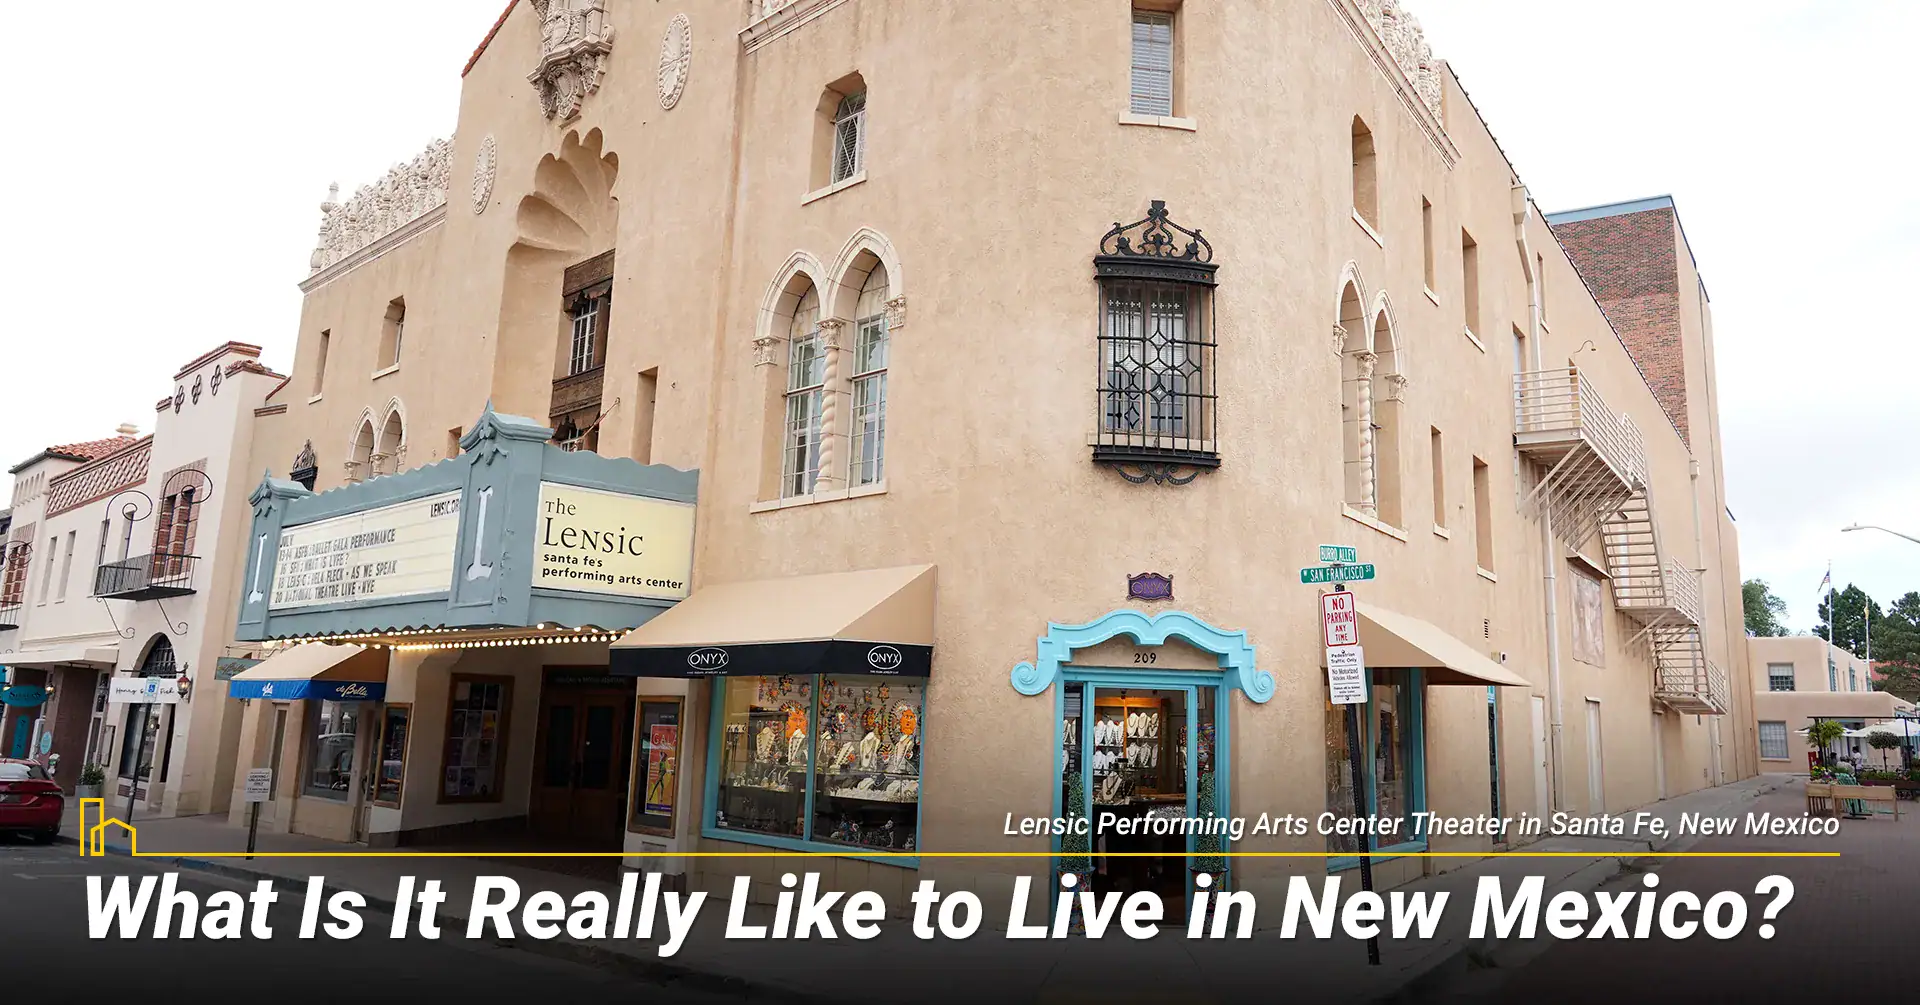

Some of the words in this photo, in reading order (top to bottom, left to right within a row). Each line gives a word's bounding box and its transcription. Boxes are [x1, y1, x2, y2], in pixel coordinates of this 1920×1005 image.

[545, 498, 576, 516] The
[280, 534, 294, 548] JULY
[333, 537, 348, 551] GALA
[350, 528, 396, 549] PERFORMANCE
[543, 553, 579, 566] santa
[583, 555, 603, 567] fe's
[1321, 547, 1338, 560] BURRO
[1339, 548, 1355, 562] ALLEY
[327, 568, 344, 582] FLECK
[351, 565, 360, 579] AS
[363, 564, 373, 578] WE
[376, 560, 397, 576] SPEAK
[1310, 569, 1324, 582] SAN
[1326, 566, 1364, 581] FRANCISCO
[542, 567, 614, 584] performing
[619, 574, 642, 585] arts
[646, 577, 683, 590] center
[315, 584, 339, 599] THEATRE
[341, 581, 356, 597] LIVE
[1132, 581, 1170, 594] ONYX
[1332, 597, 1345, 610] NO
[1327, 611, 1352, 624] PARKING
[1335, 624, 1347, 632] ANY
[1335, 633, 1348, 641] TIME
[690, 653, 726, 665] ONYX
[870, 652, 899, 663] ONYX
[1134, 652, 1157, 664] 209
